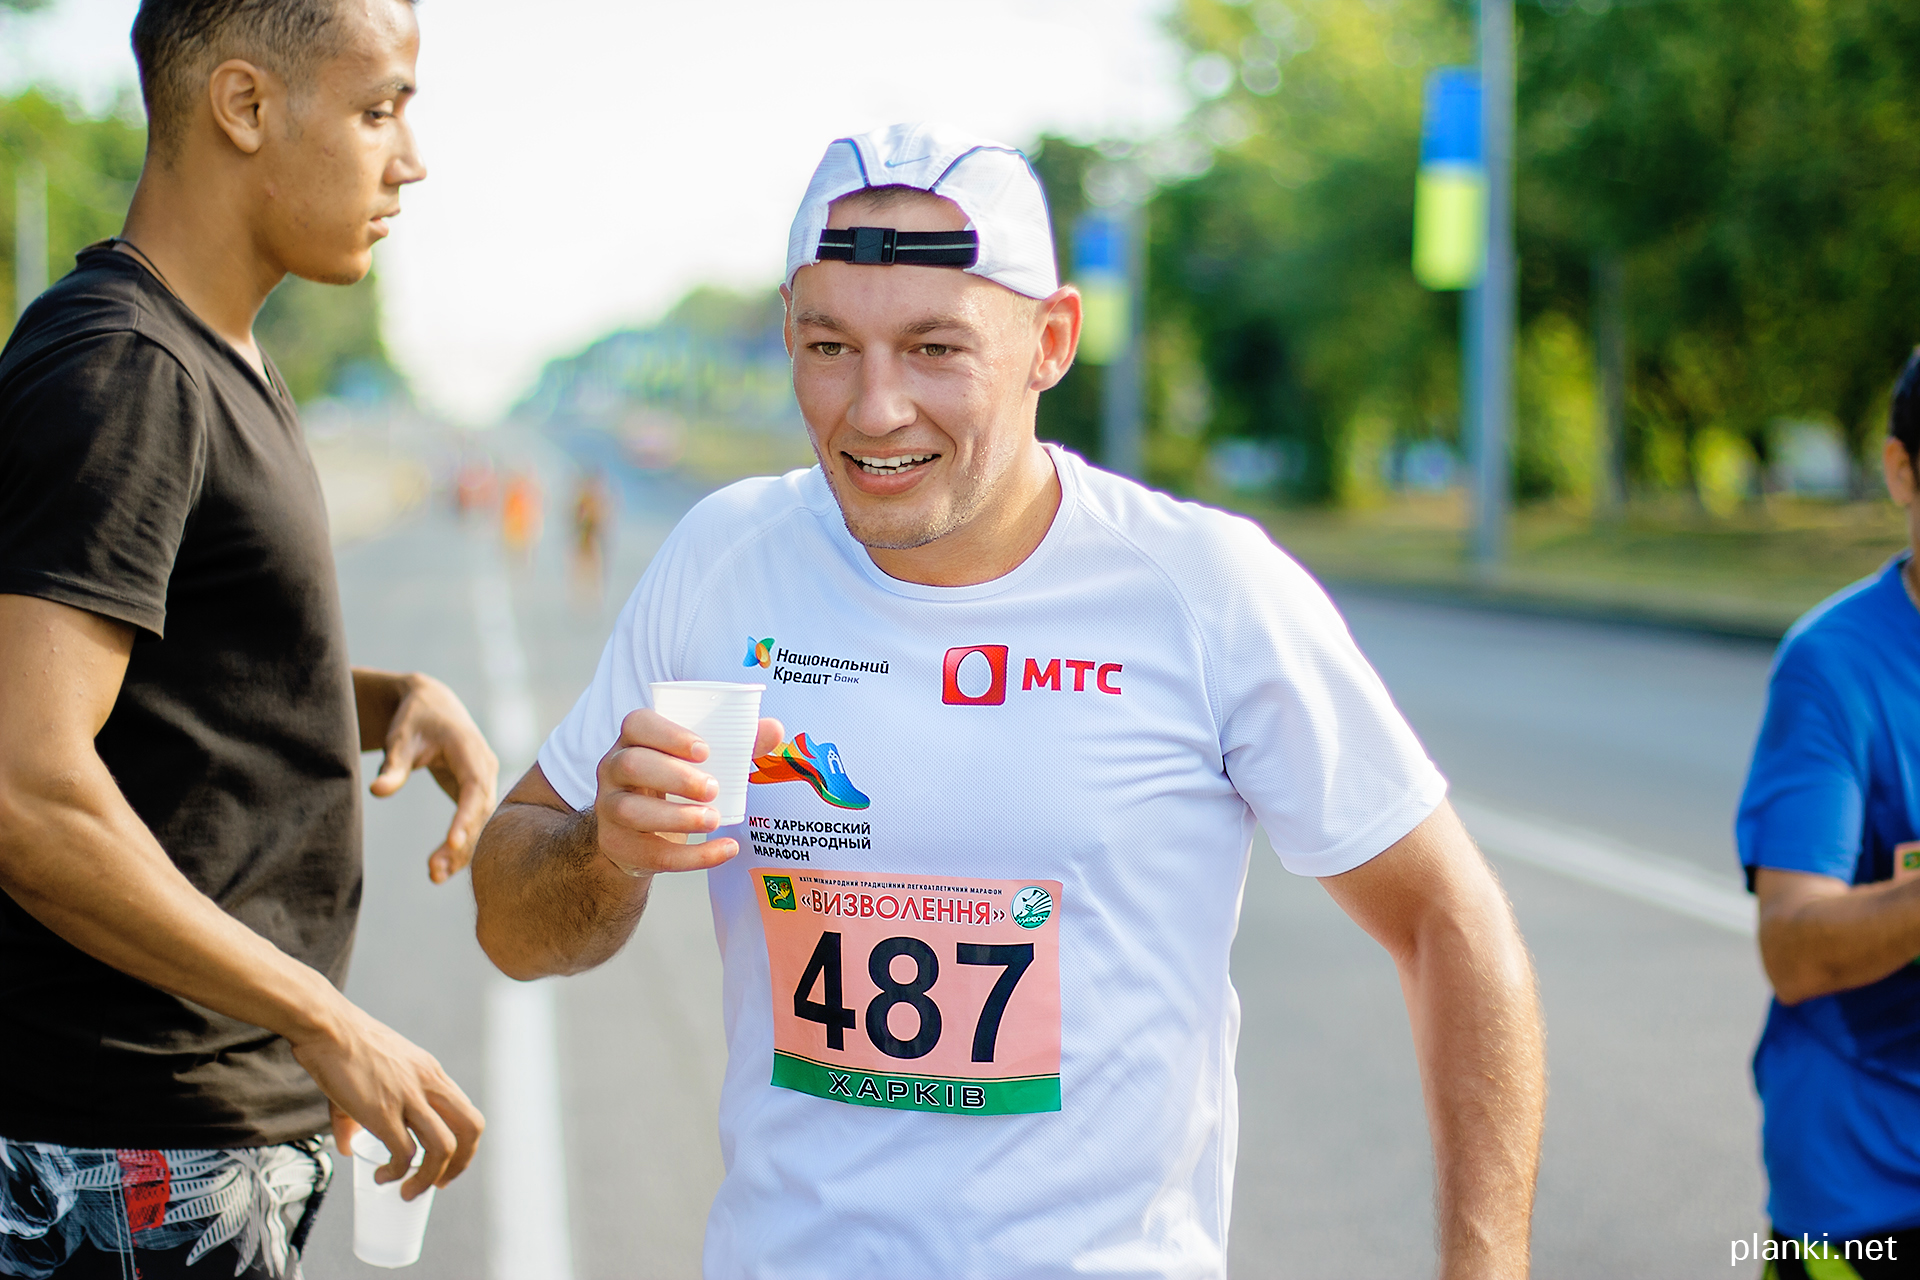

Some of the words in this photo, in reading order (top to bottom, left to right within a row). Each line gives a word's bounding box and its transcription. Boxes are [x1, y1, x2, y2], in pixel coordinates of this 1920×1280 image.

[776, 648, 890, 674] Національний
[773, 666, 832, 685] Кредит
[833, 673, 860, 684] Банк
[1021, 657, 1123, 695] МТС
[749, 816, 771, 829] МТС
[773, 818, 871, 835] ХАРЬКОВСКИЙ
[750, 831, 871, 851] МЕЖДУНАРОДНЫЙ
[753, 845, 810, 861] МАРАФОН
[860, 881, 906, 889] ТРАДИЦІЙНИЙ
[907, 883, 968, 893] ЛЕГКОАТЛЕТИЧНИЙ
[970, 887, 1003, 895] МАРАФОН
[801, 889, 1006, 925] «ВИЗВОЛЕННЯ»
[793, 930, 1035, 1063] 487
[829, 1071, 986, 1109] ХАРКІВ
